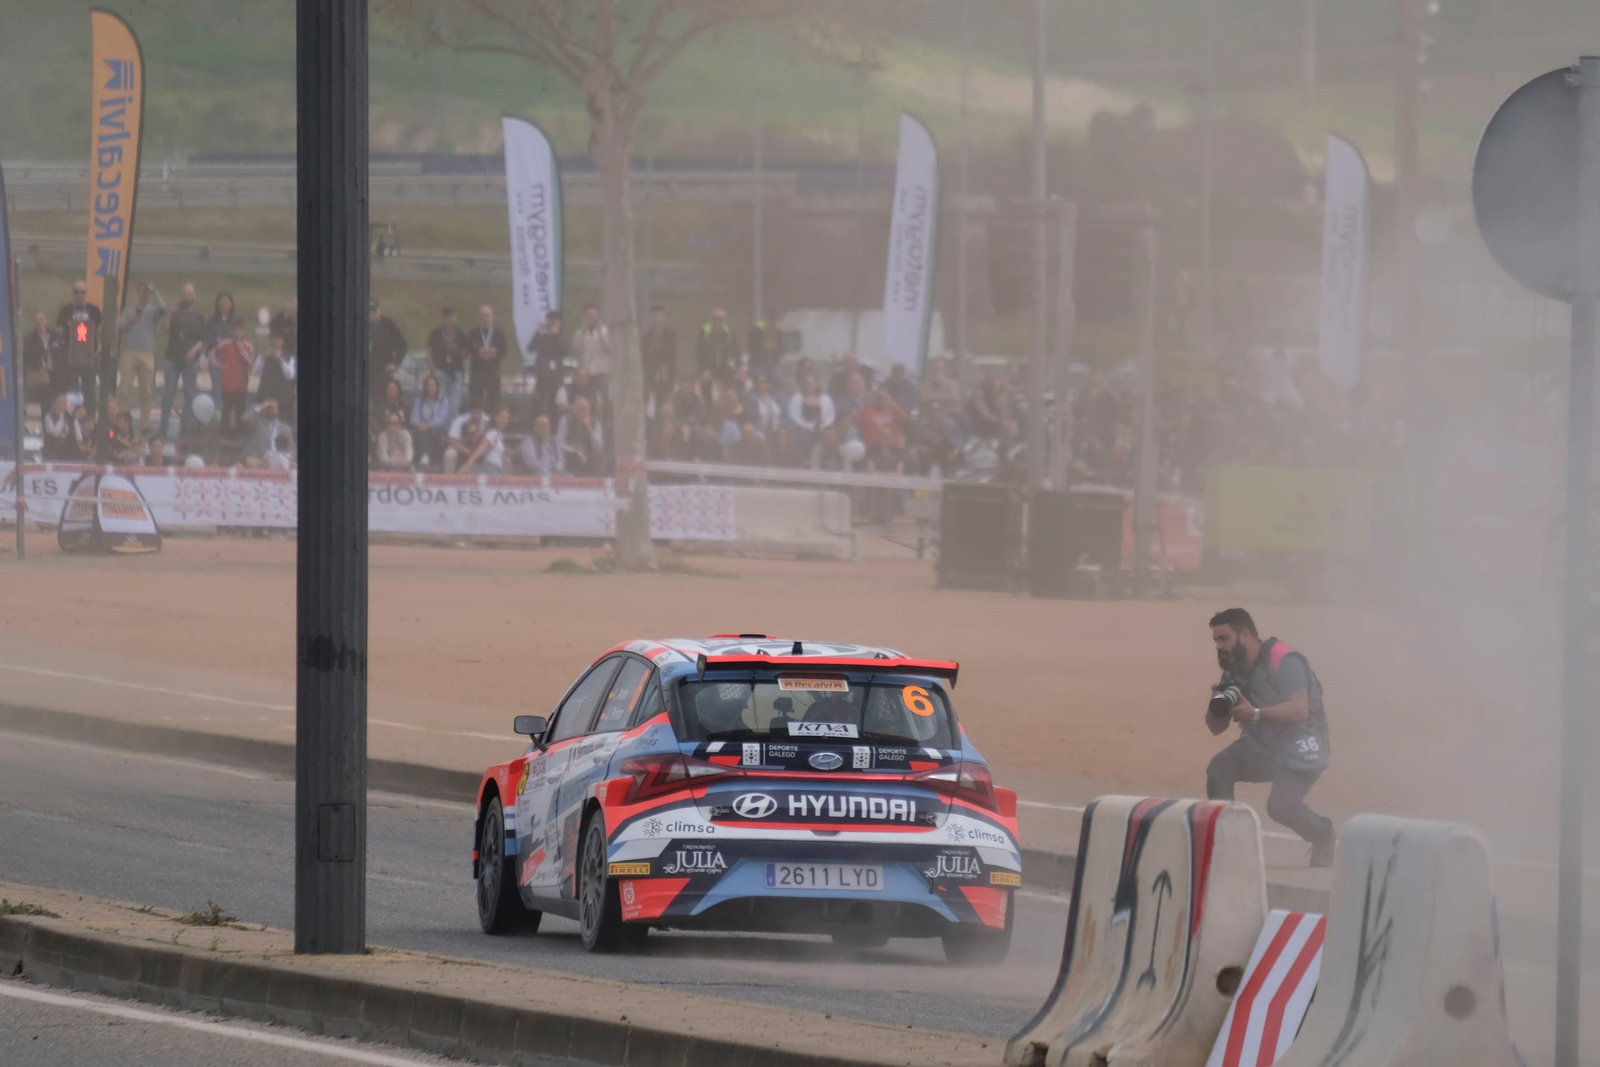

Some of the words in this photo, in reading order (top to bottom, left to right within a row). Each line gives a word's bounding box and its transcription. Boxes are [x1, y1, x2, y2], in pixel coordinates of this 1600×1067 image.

[32, 479, 58, 496] ES
[456, 489, 484, 506] ES
[901, 685, 935, 718] 6
[797, 722, 850, 732] KTVA
[768, 744, 799, 752] DEPORTE
[878, 747, 907, 755] DEPORTE
[1295, 736, 1320, 753] 36
[768, 751, 796, 759] GALEGO
[788, 794, 917, 824] HYUNDAI
[665, 821, 716, 835] climsa
[967, 828, 1006, 845] climsa
[610, 864, 649, 874] PIRELLI
[663, 850, 728, 874] JULIA
[924, 854, 982, 878] JULIA
[779, 865, 829, 886] 2611
[839, 867, 878, 888] LYD
